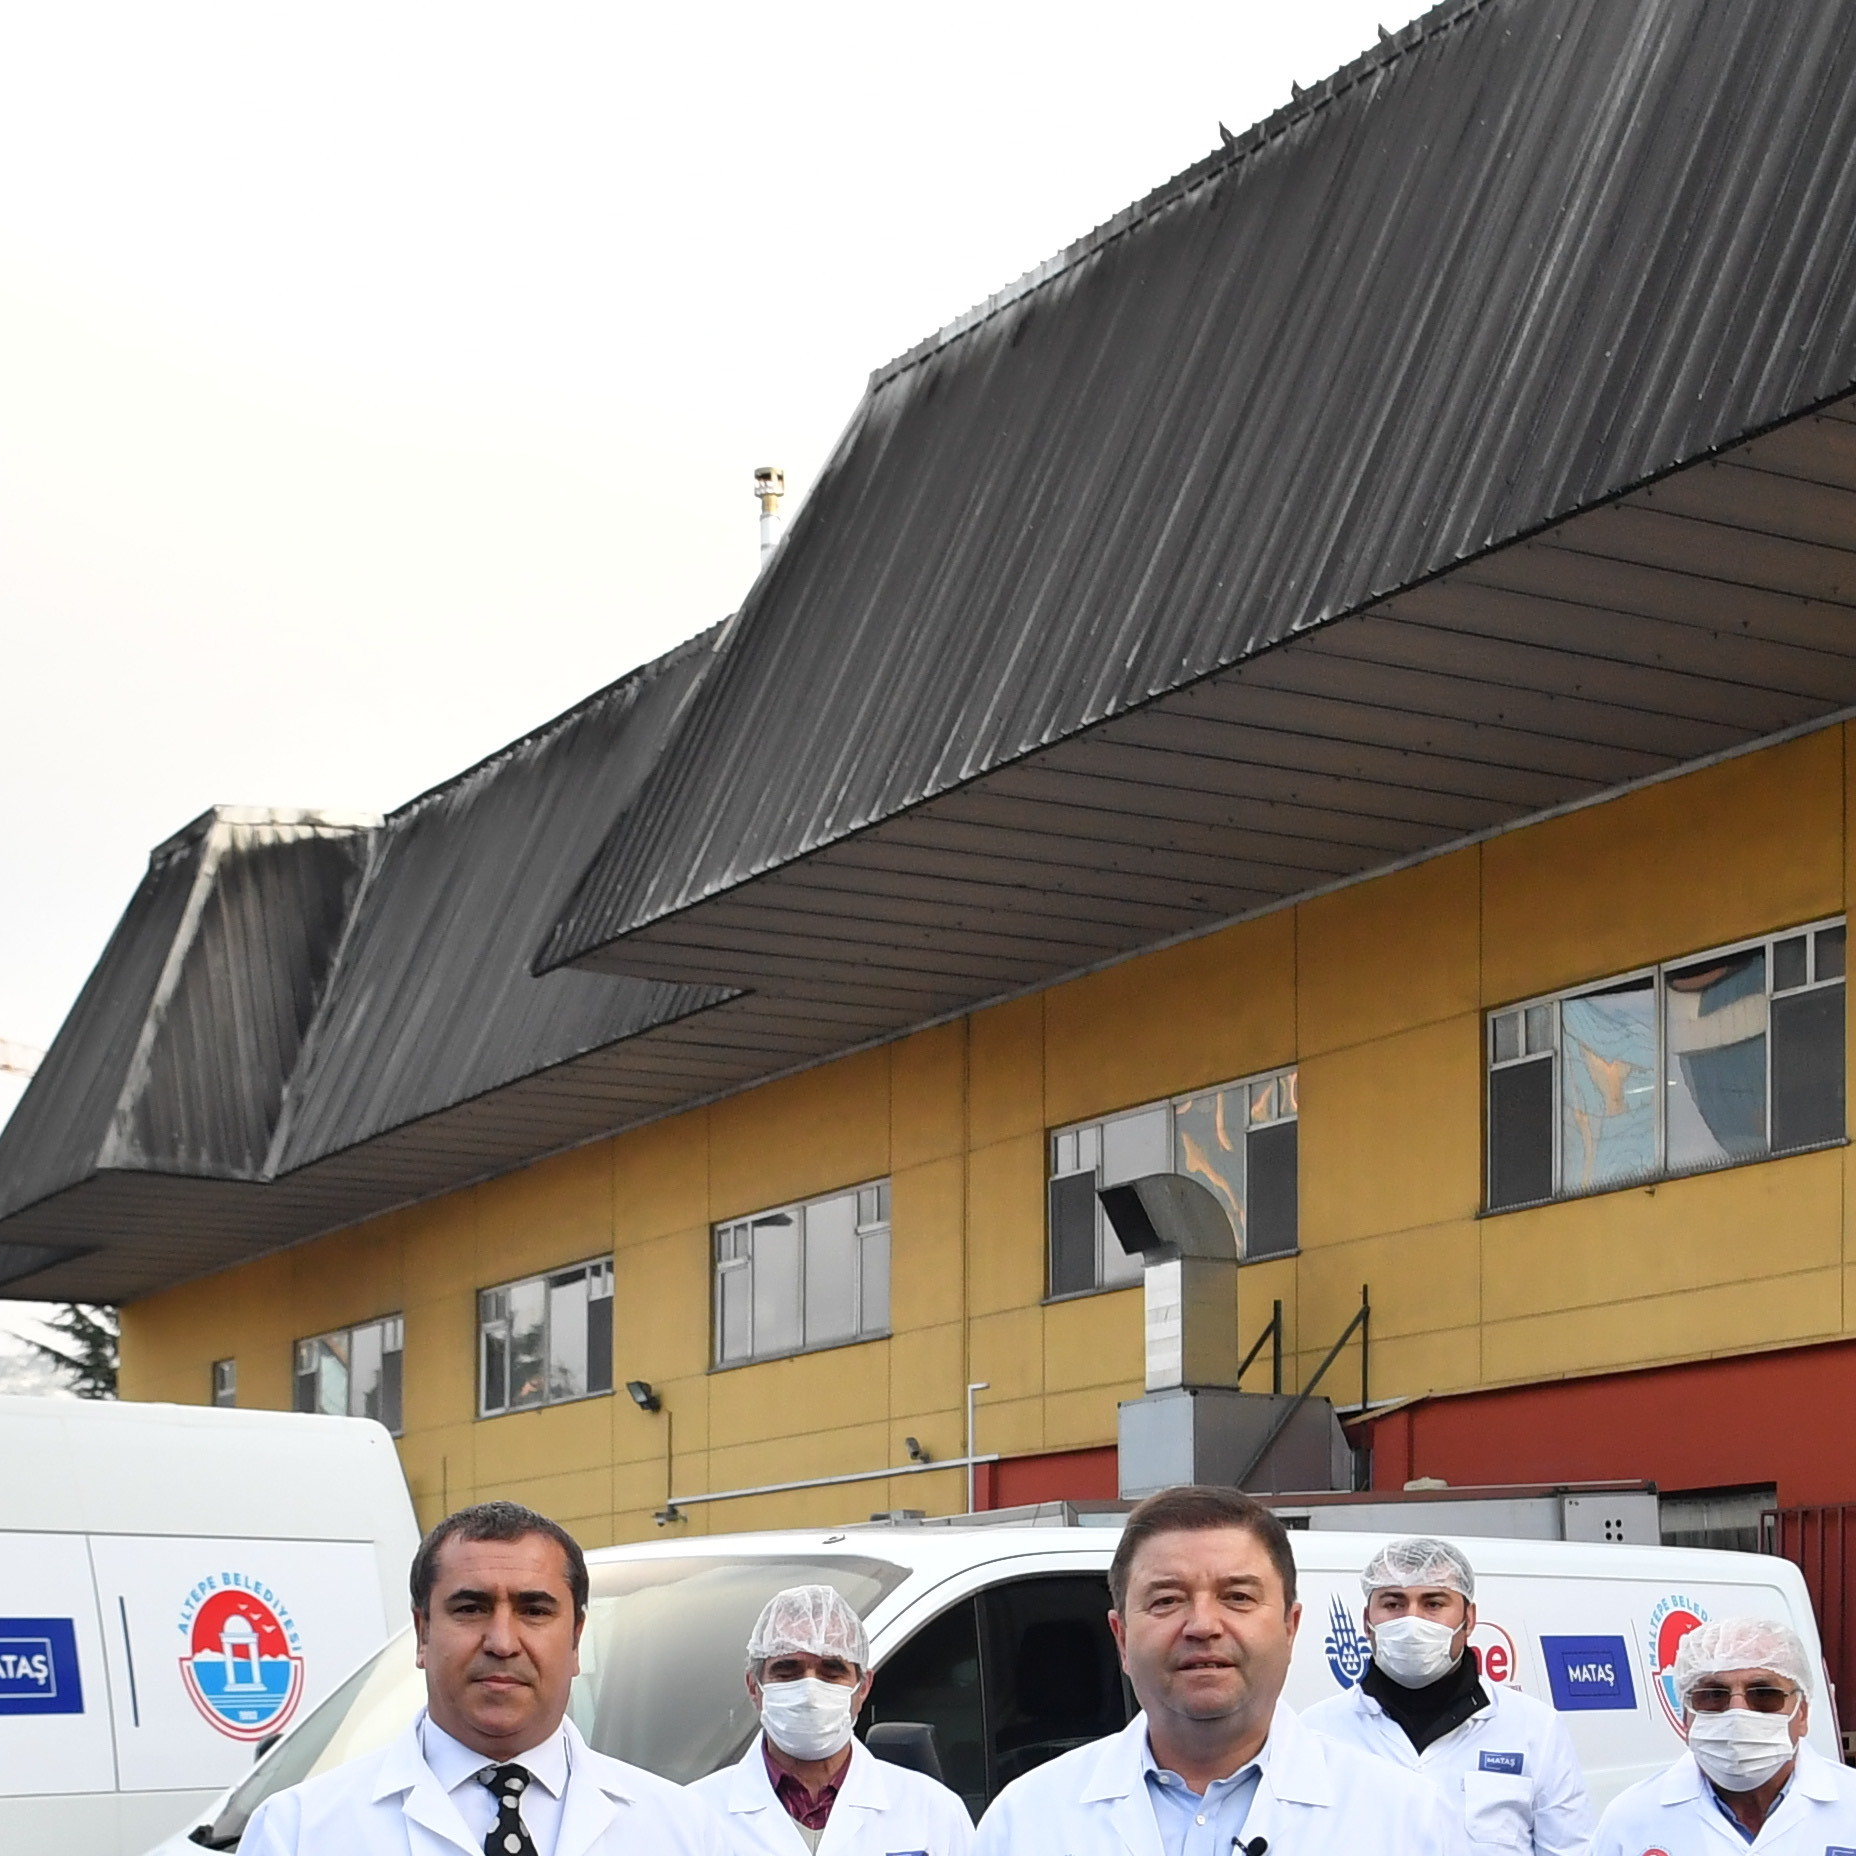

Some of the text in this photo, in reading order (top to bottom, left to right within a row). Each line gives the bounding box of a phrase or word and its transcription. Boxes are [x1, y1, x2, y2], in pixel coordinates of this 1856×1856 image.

[1648, 1595, 1709, 1667] MALTEPE BELED
[1567, 1663, 1616, 1687] MATAŞ
